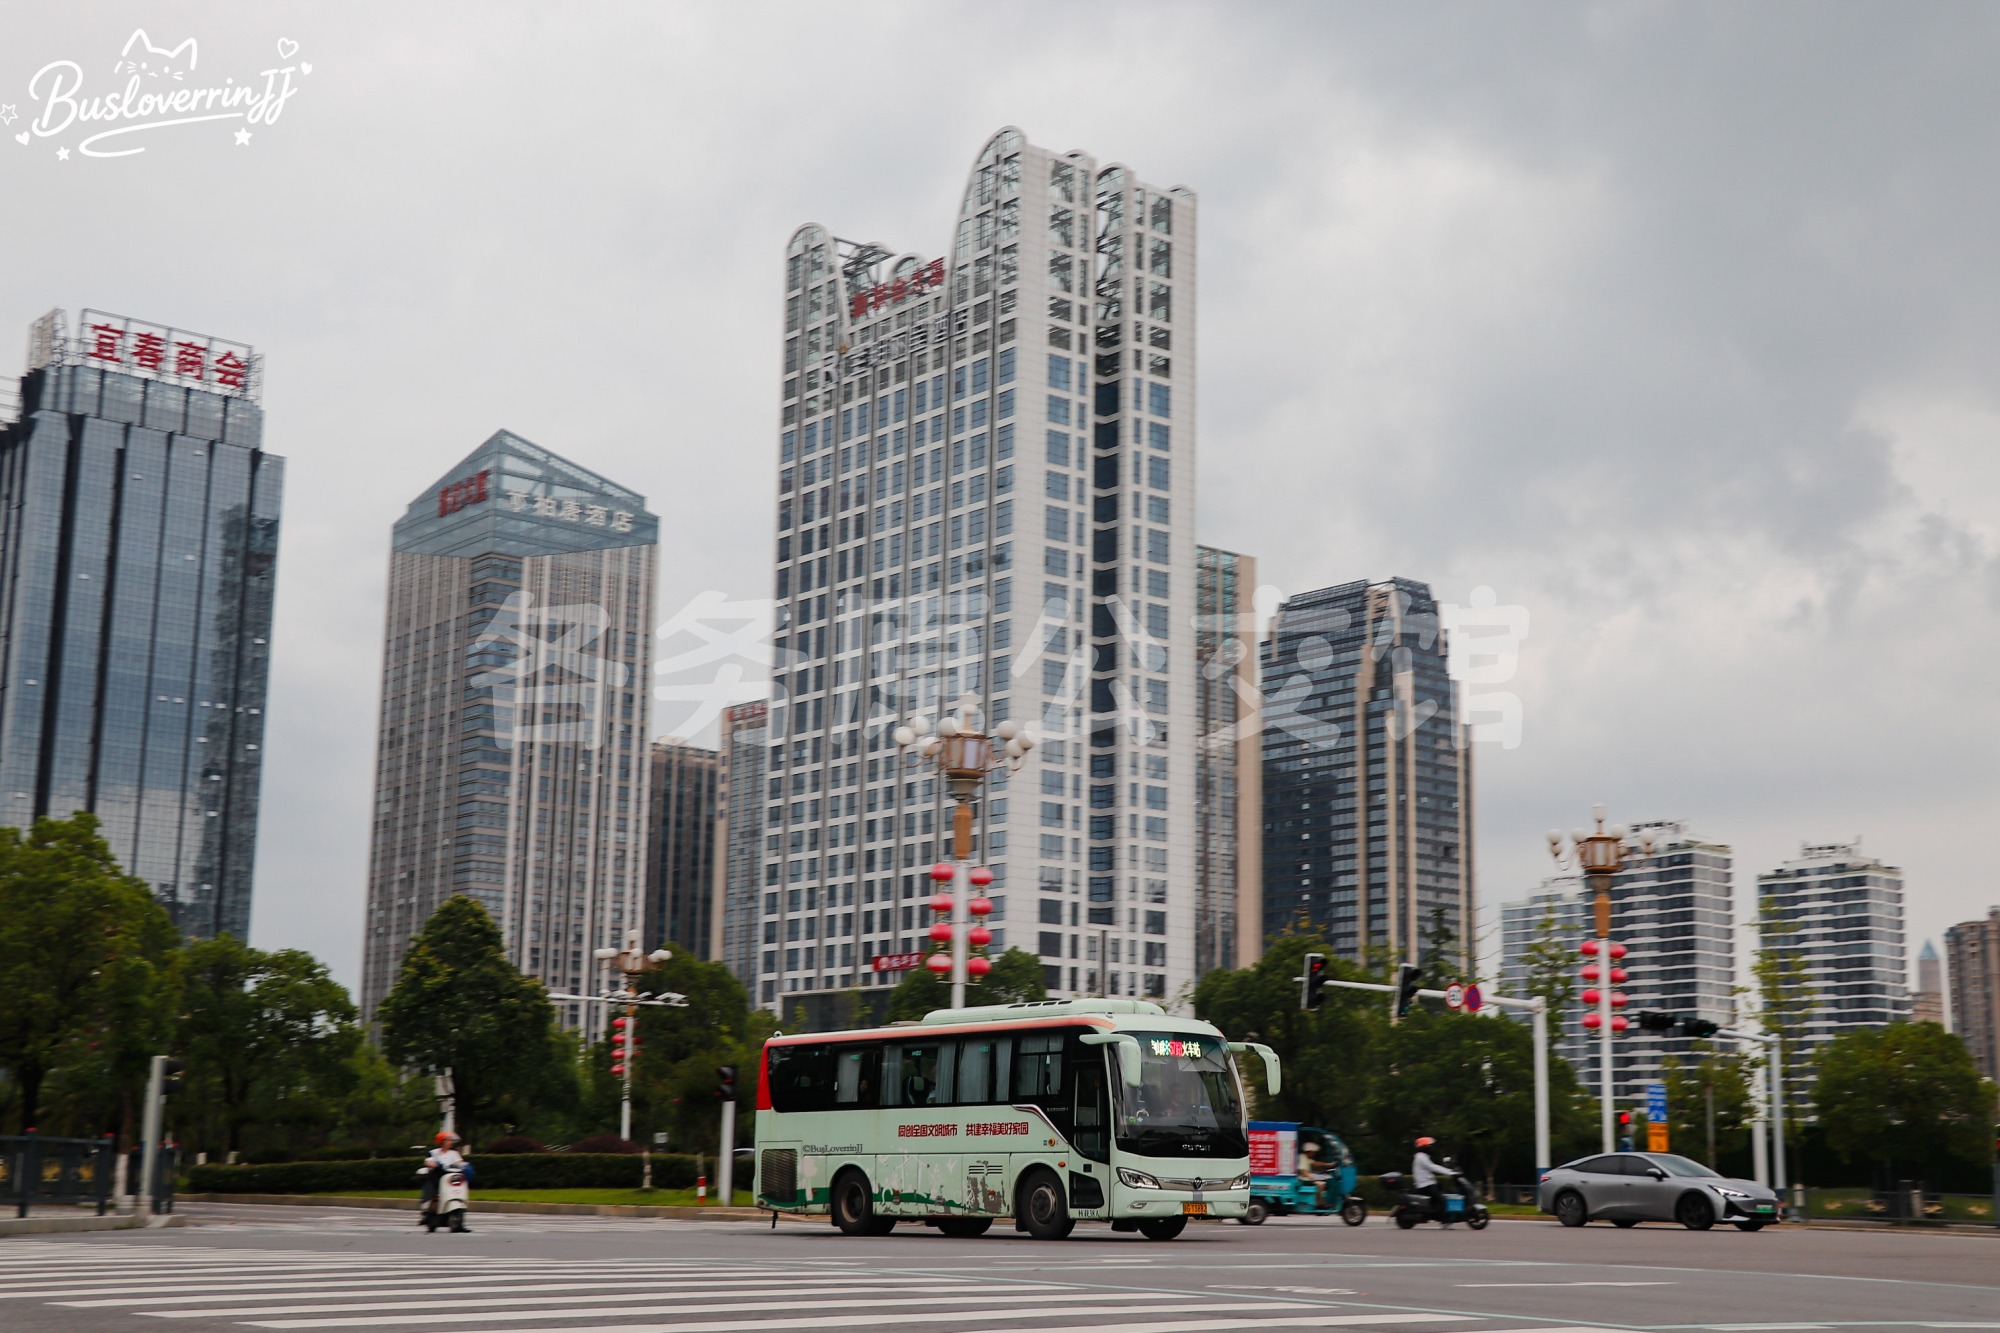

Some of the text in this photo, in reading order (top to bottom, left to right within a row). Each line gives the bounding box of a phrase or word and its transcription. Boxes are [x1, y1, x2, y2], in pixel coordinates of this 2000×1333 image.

[88, 323, 248, 388] 宜春商会
[965, 1122, 1029, 1136] 共建幸福美好家园
